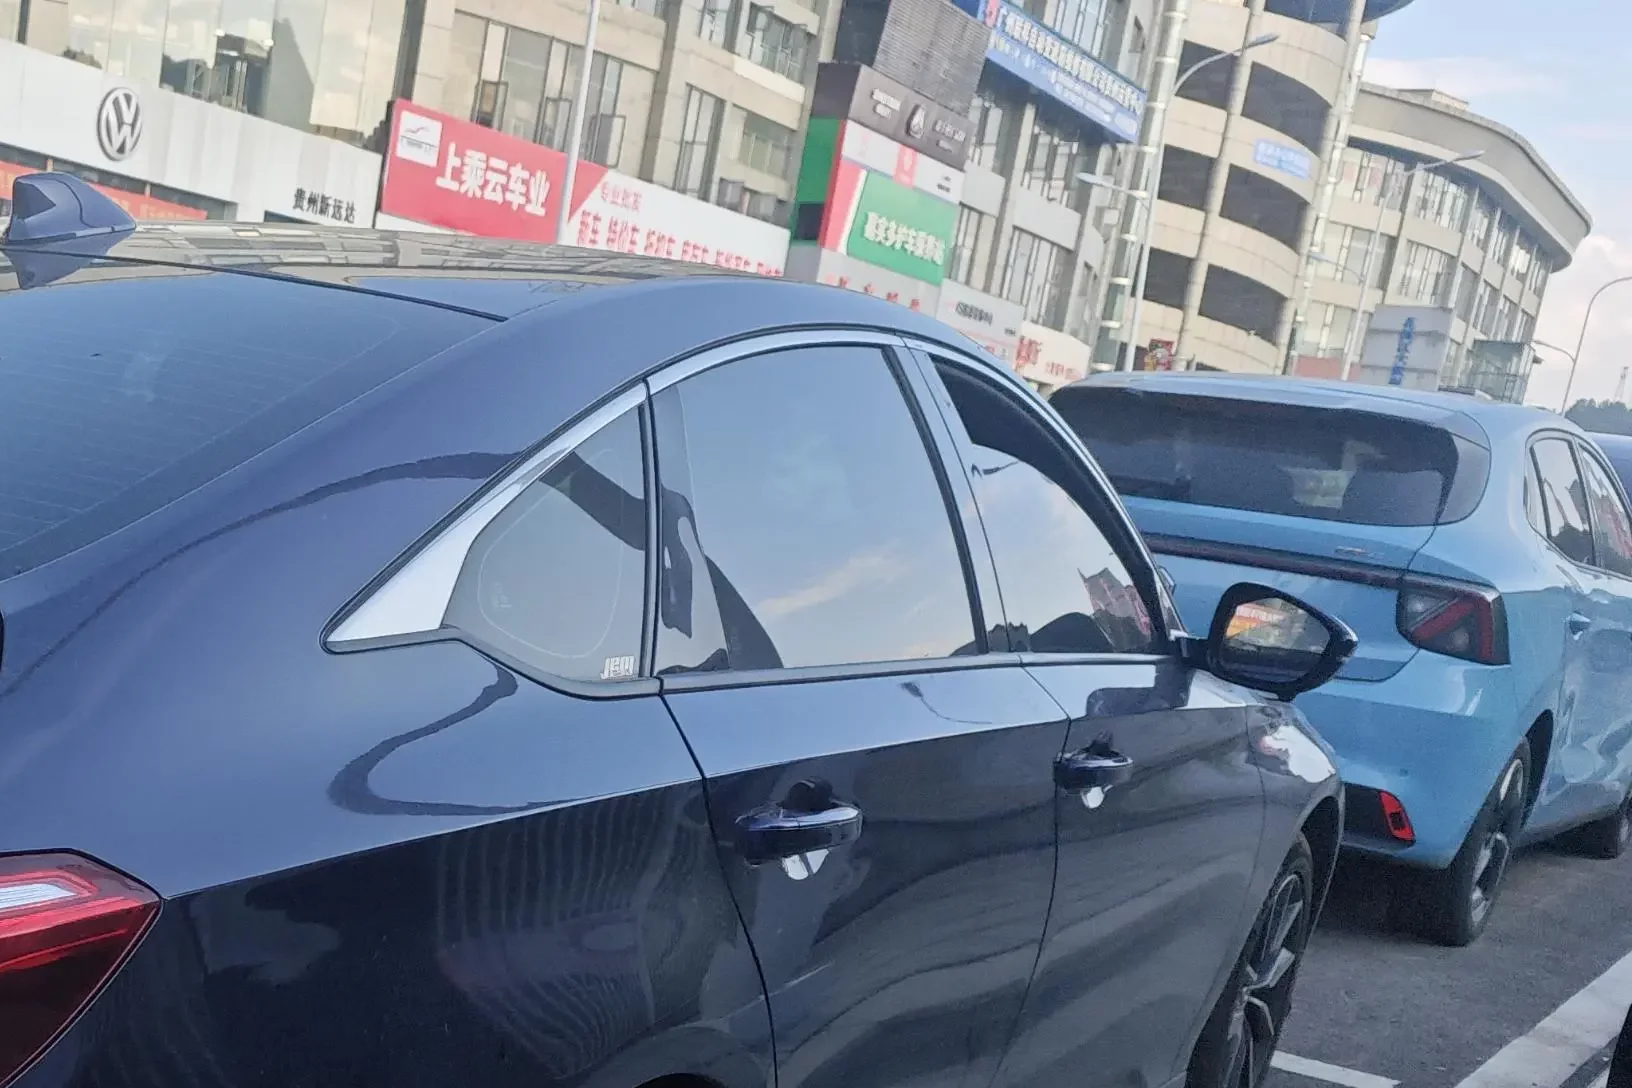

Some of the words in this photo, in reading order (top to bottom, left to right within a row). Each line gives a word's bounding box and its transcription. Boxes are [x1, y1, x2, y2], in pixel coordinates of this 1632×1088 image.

[435, 141, 551, 217] 上乘云车业
